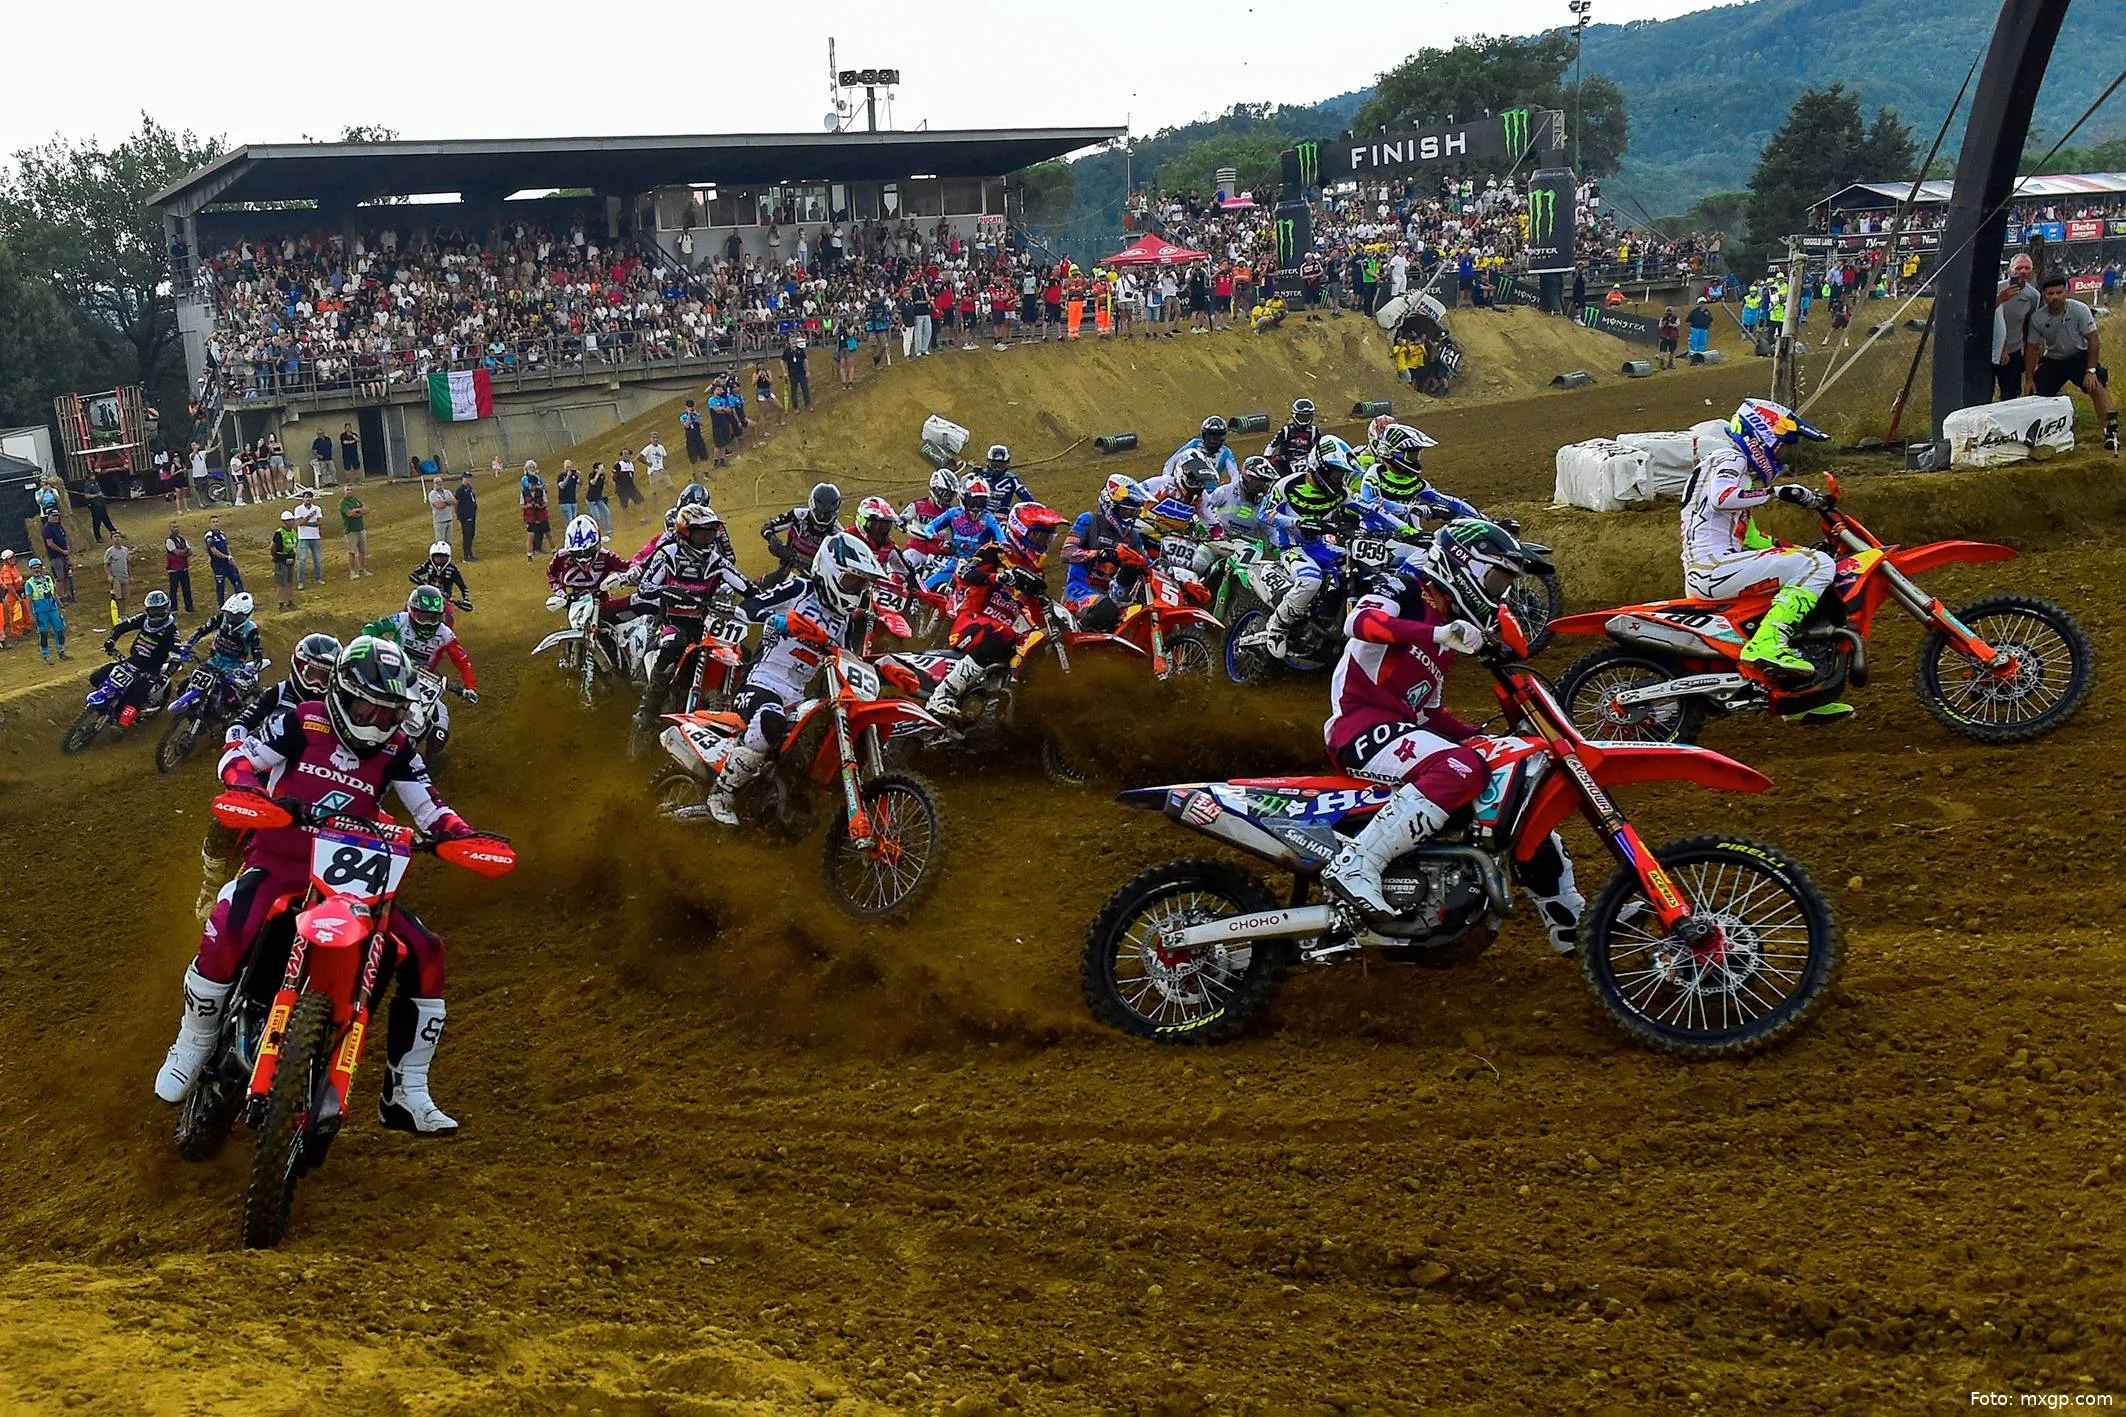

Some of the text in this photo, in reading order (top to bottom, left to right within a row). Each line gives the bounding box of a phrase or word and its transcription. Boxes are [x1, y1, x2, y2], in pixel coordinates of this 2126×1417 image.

[1351, 131, 1467, 170] FINISH
[980, 216, 1003, 224] DUCATI
[2071, 223, 2097, 232] Beta
[1602, 316, 1646, 332] MONSTER
[1745, 412, 1777, 447] 100%
[2037, 416, 2067, 439] UFO
[1168, 543, 1195, 560] 303
[1355, 541, 1387, 562] 959
[1450, 545, 1470, 561] FOX
[1261, 571, 1286, 591] 959
[876, 591, 904, 611] 24
[1160, 583, 1180, 607] 5
[846, 665, 877, 694] 83
[1354, 722, 1417, 761] FOX
[297, 761, 376, 797] HONDA
[1346, 767, 1403, 783] HONDA
[1284, 828, 1307, 848] Satu
[1715, 842, 1786, 868] PIRELLI
[322, 846, 392, 896] 84
[1229, 915, 1280, 932] CHOHO
[1154, 1007, 1226, 1034] PIRELLI
